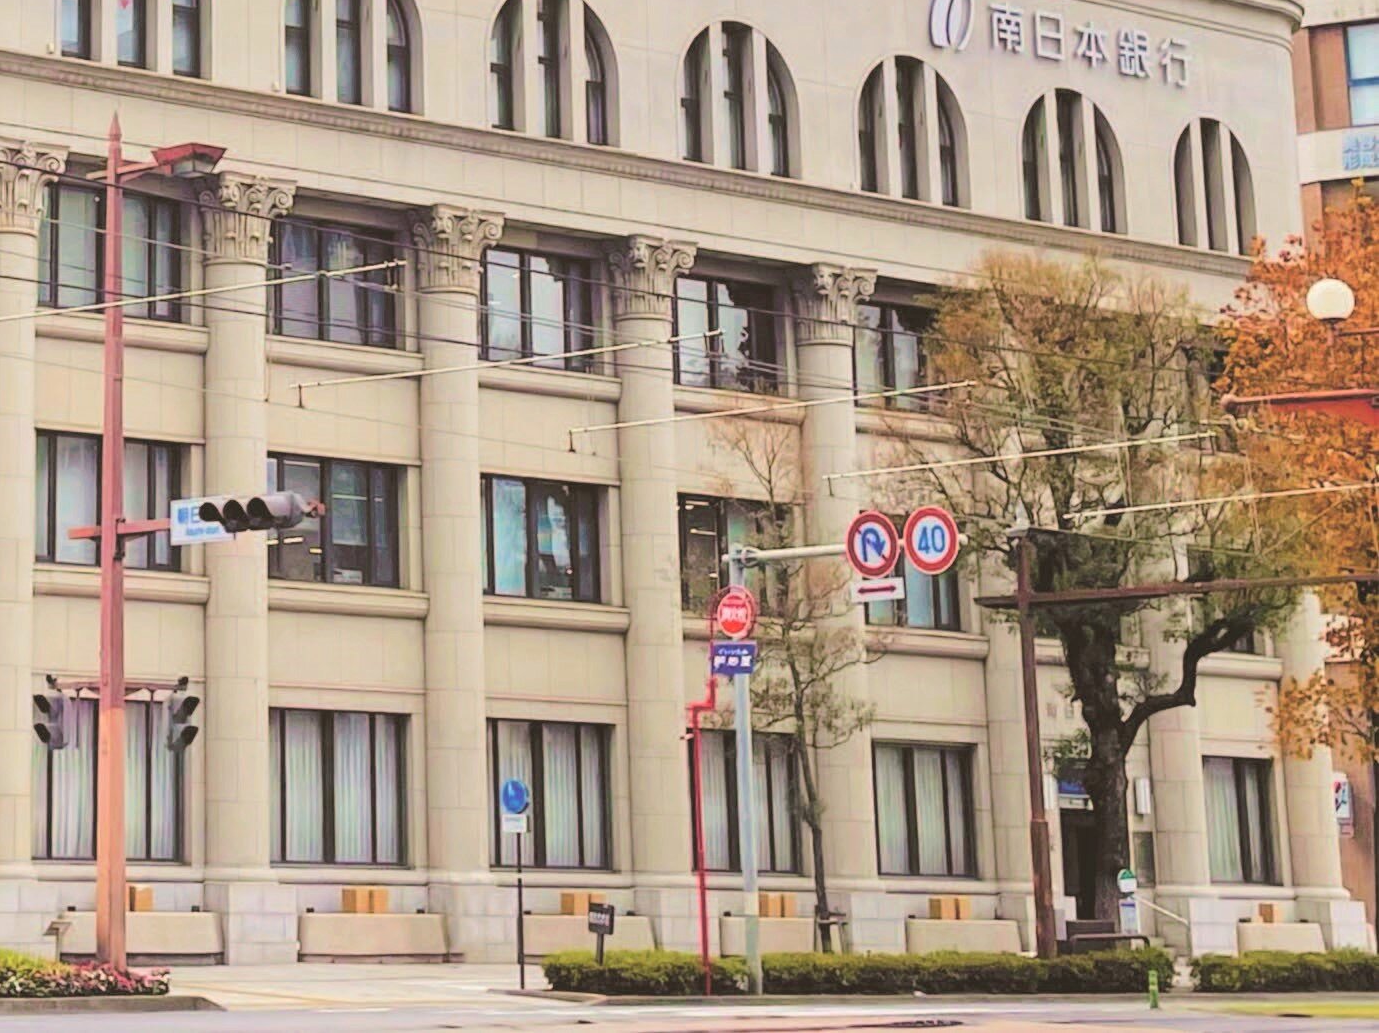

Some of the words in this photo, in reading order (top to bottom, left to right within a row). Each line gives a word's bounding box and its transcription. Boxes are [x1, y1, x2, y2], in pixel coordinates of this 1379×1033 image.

[988, 2, 1192, 88] 南日本銀行
[918, 525, 946, 554] 40
